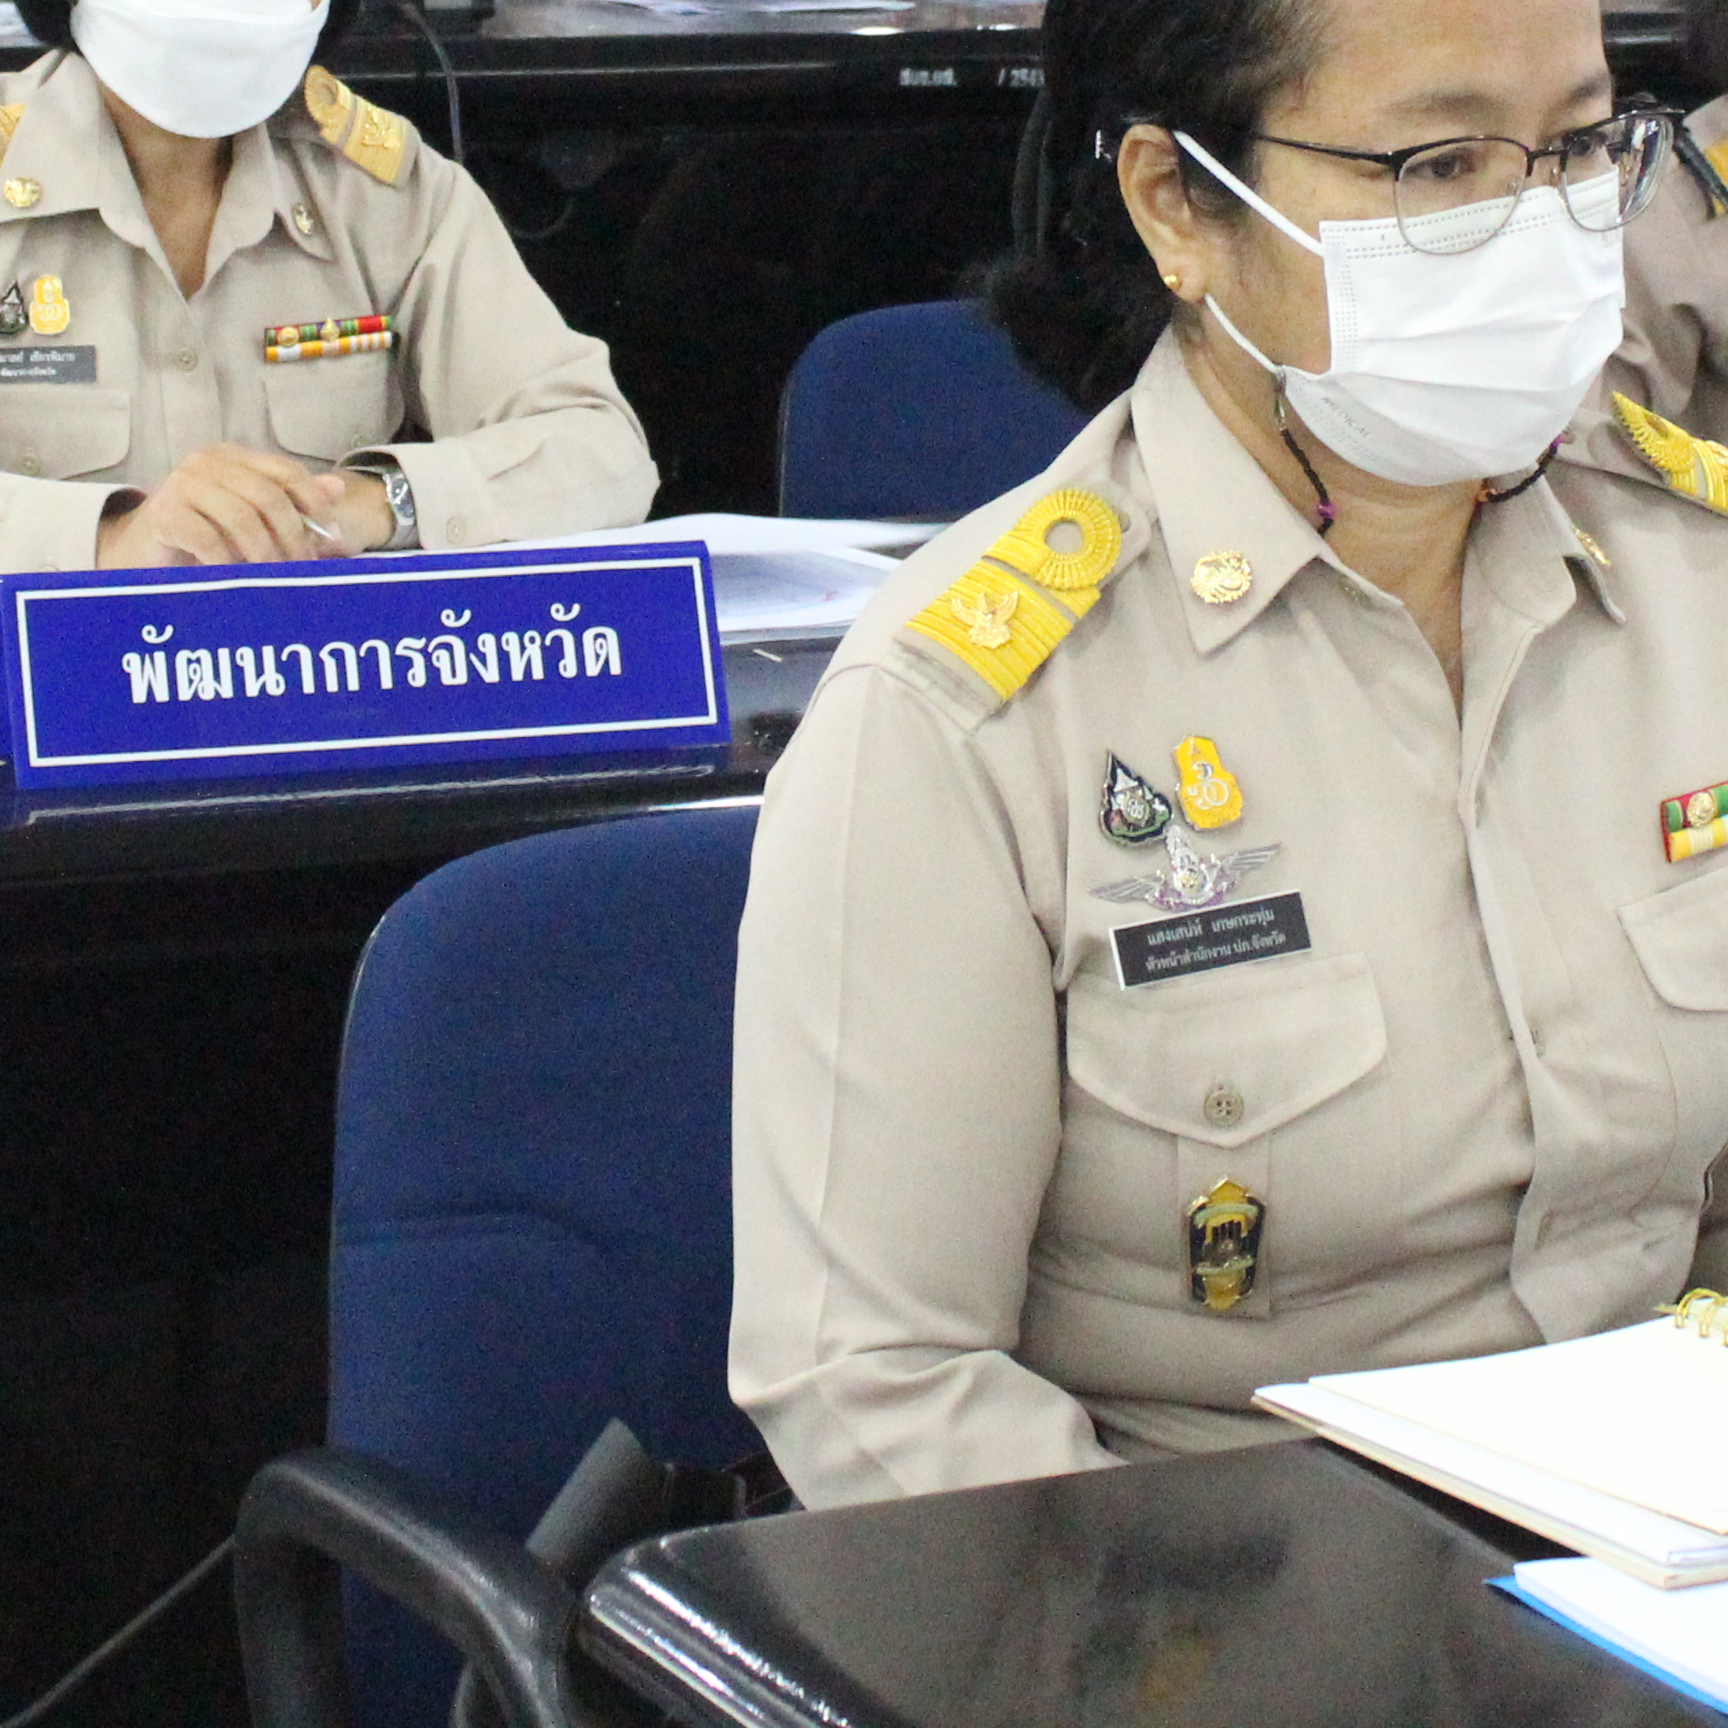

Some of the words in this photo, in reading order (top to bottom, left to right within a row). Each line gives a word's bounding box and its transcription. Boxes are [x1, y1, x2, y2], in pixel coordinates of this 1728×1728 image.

[121, 602, 622, 704] พัฒนาการจังหวัด
